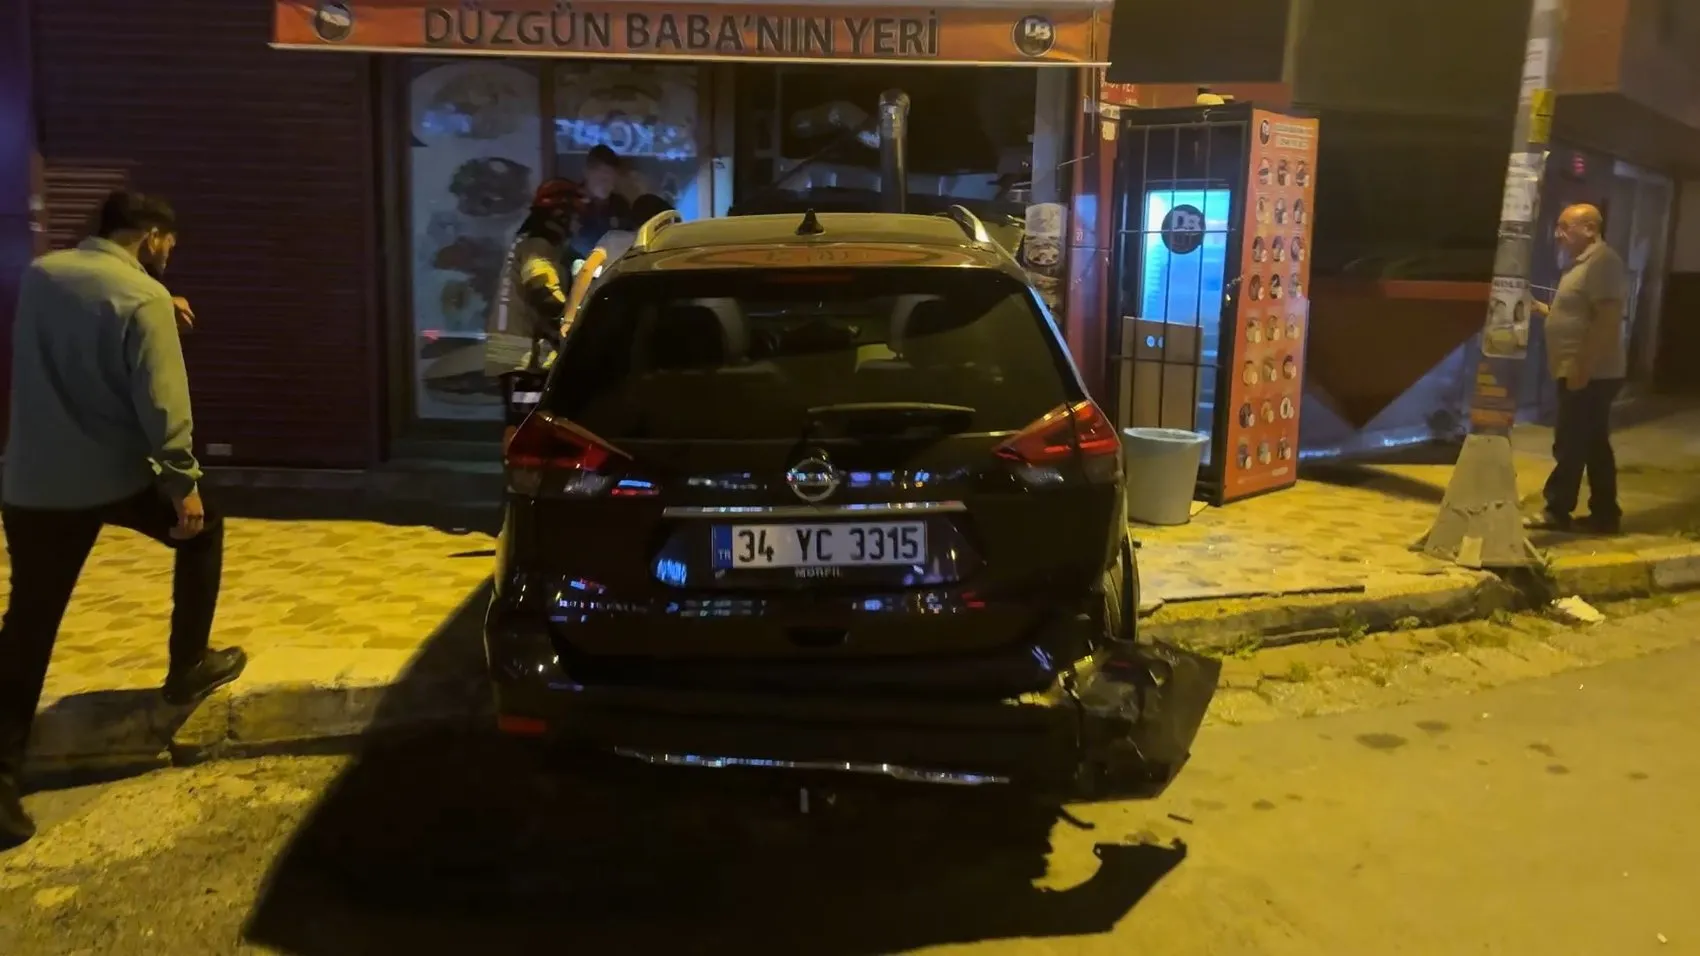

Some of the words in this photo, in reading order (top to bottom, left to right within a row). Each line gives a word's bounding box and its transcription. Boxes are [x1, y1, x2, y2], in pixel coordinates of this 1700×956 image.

[424, 3, 610, 48] DÜZGÜN
[626, 12, 834, 55] BABA'NIN
[845, 10, 938, 57] YERİ
[737, 528, 774, 563] 34
[796, 527, 833, 562] YC
[848, 526, 920, 561] 3315
